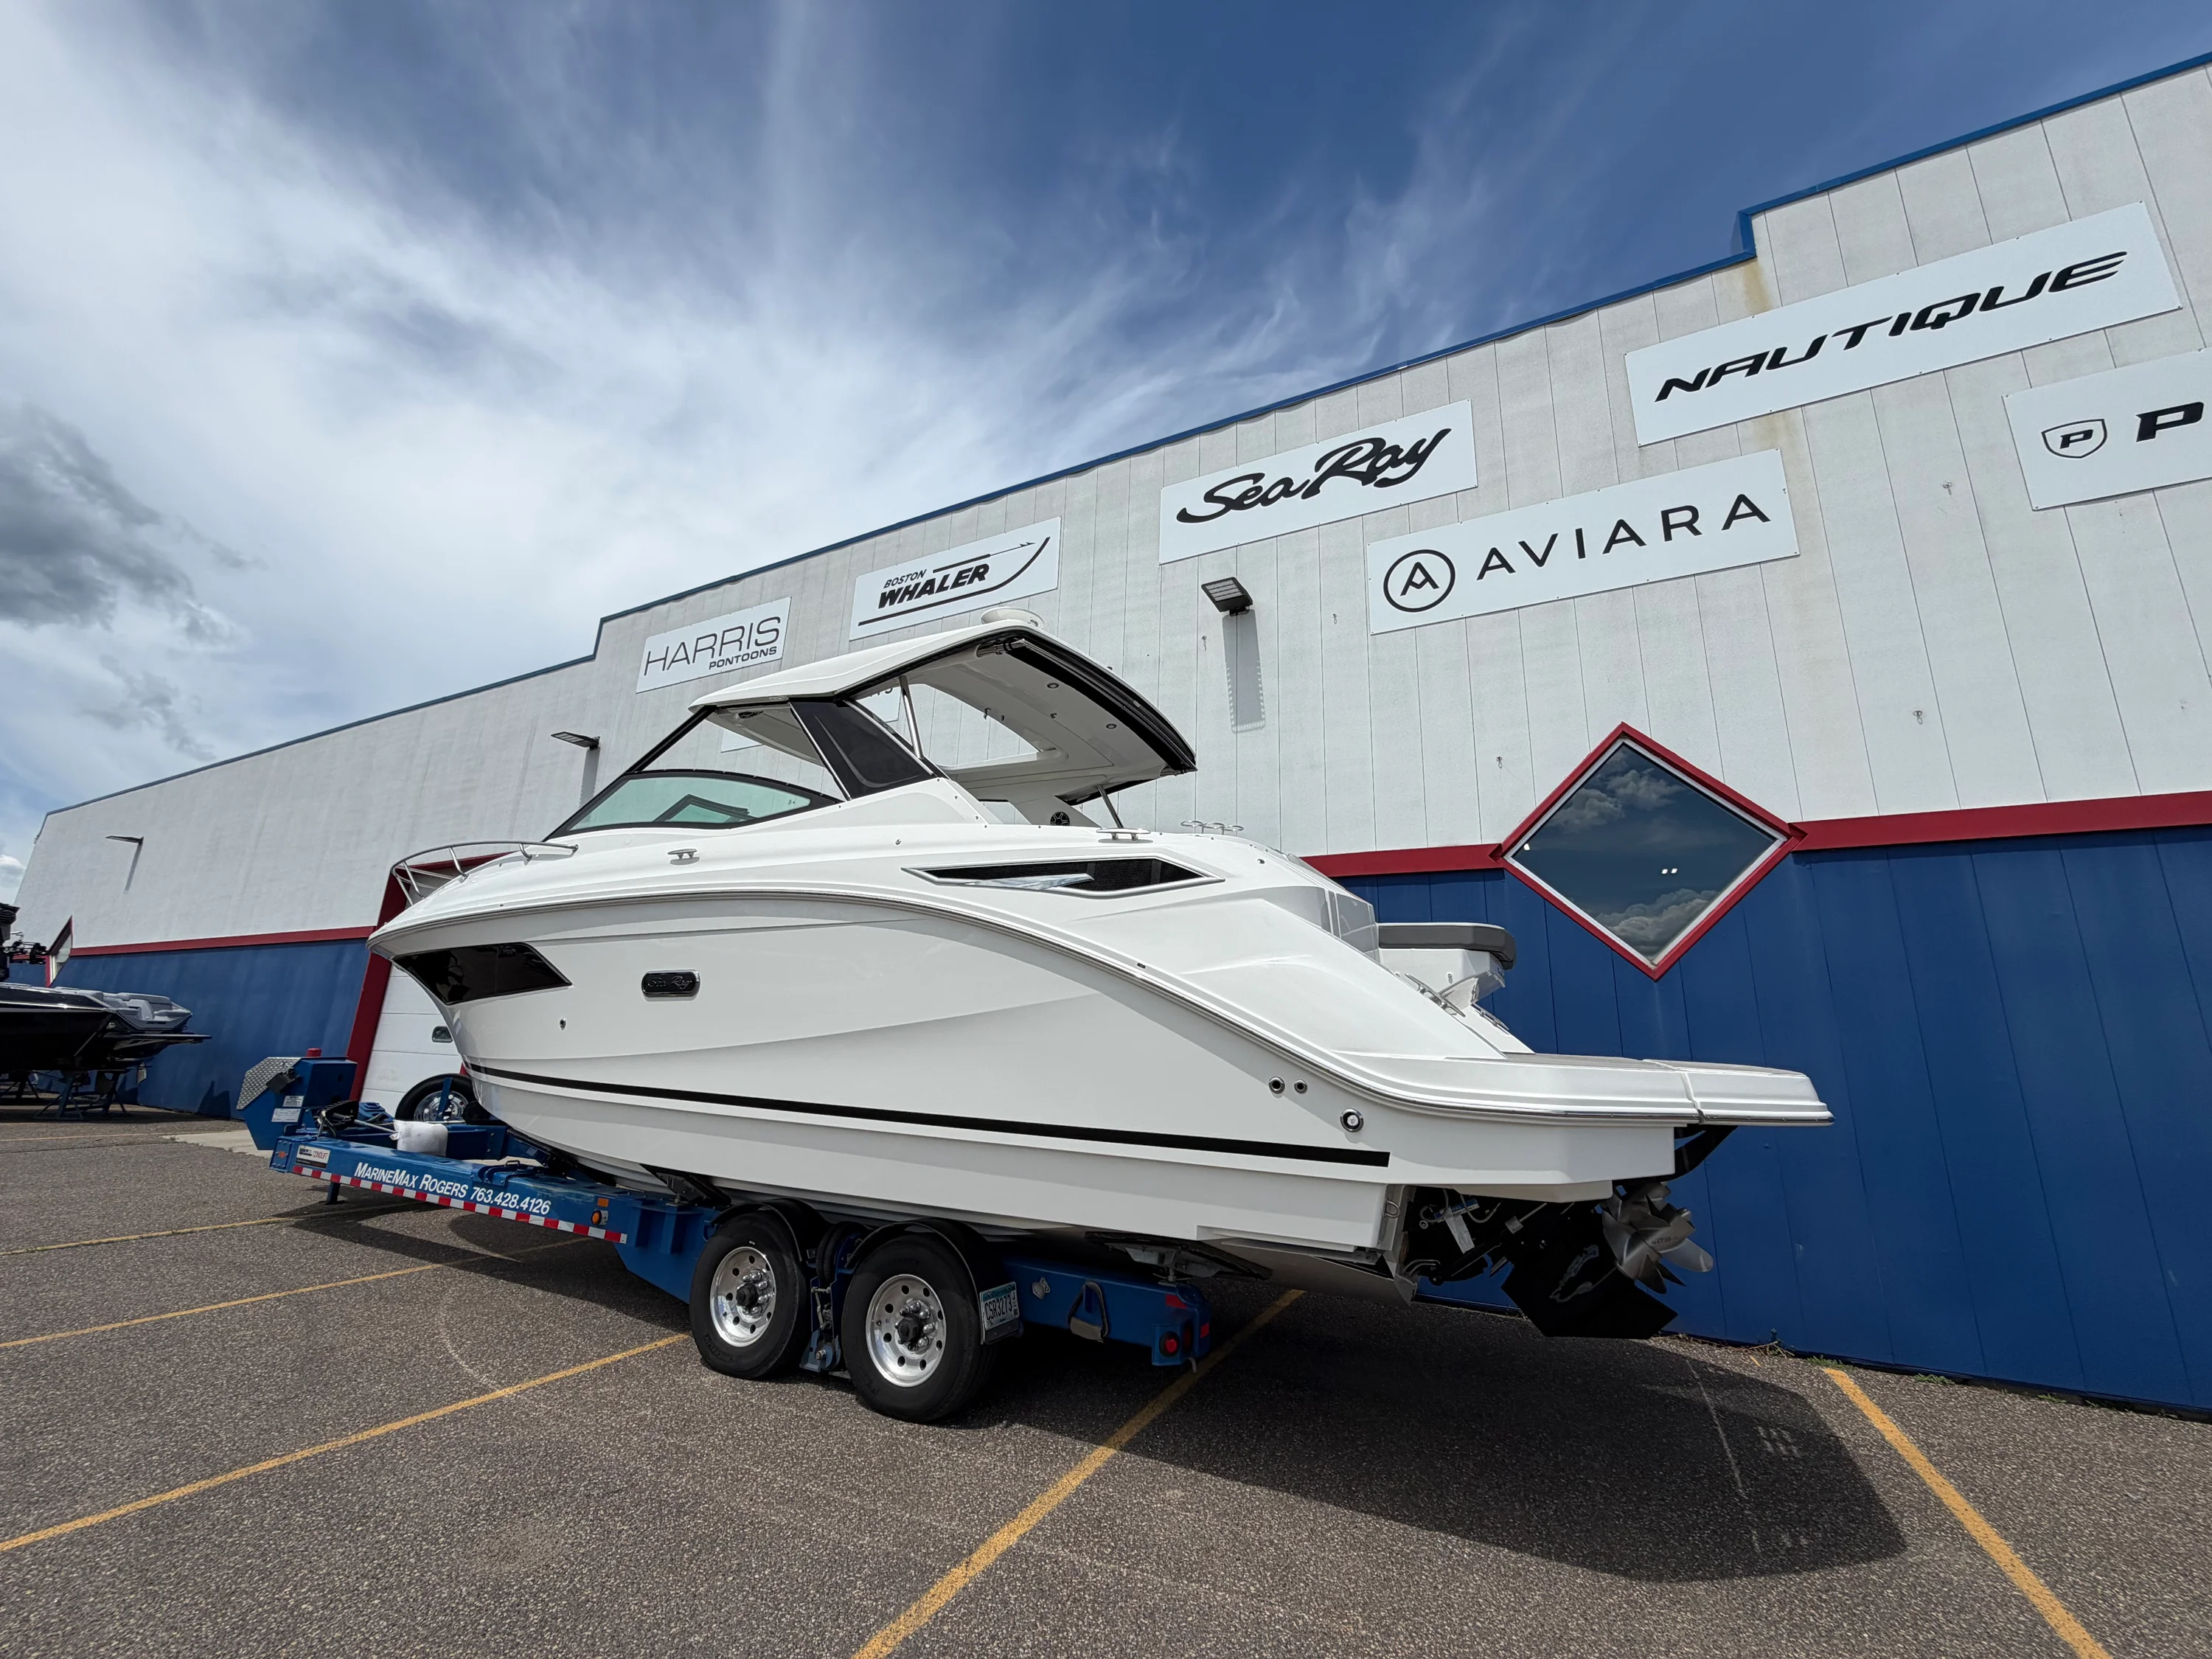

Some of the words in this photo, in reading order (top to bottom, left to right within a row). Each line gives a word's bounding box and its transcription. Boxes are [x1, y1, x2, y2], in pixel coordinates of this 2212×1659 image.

[1654, 251, 2128, 403] NAUTIQUE
[1176, 473, 1310, 524] Sea
[1301, 428, 1452, 500] Ray
[1476, 493, 1771, 580] AVIARA
[878, 563, 990, 609] WHALER
[883, 569, 927, 588] BOSTON
[644, 616, 781, 676] HARRIS
[709, 647, 777, 669] PONTOONS
[647, 978, 667, 987] Sea
[671, 975, 692, 990] Ray
[470, 1186, 552, 1215] 763.428.4126
